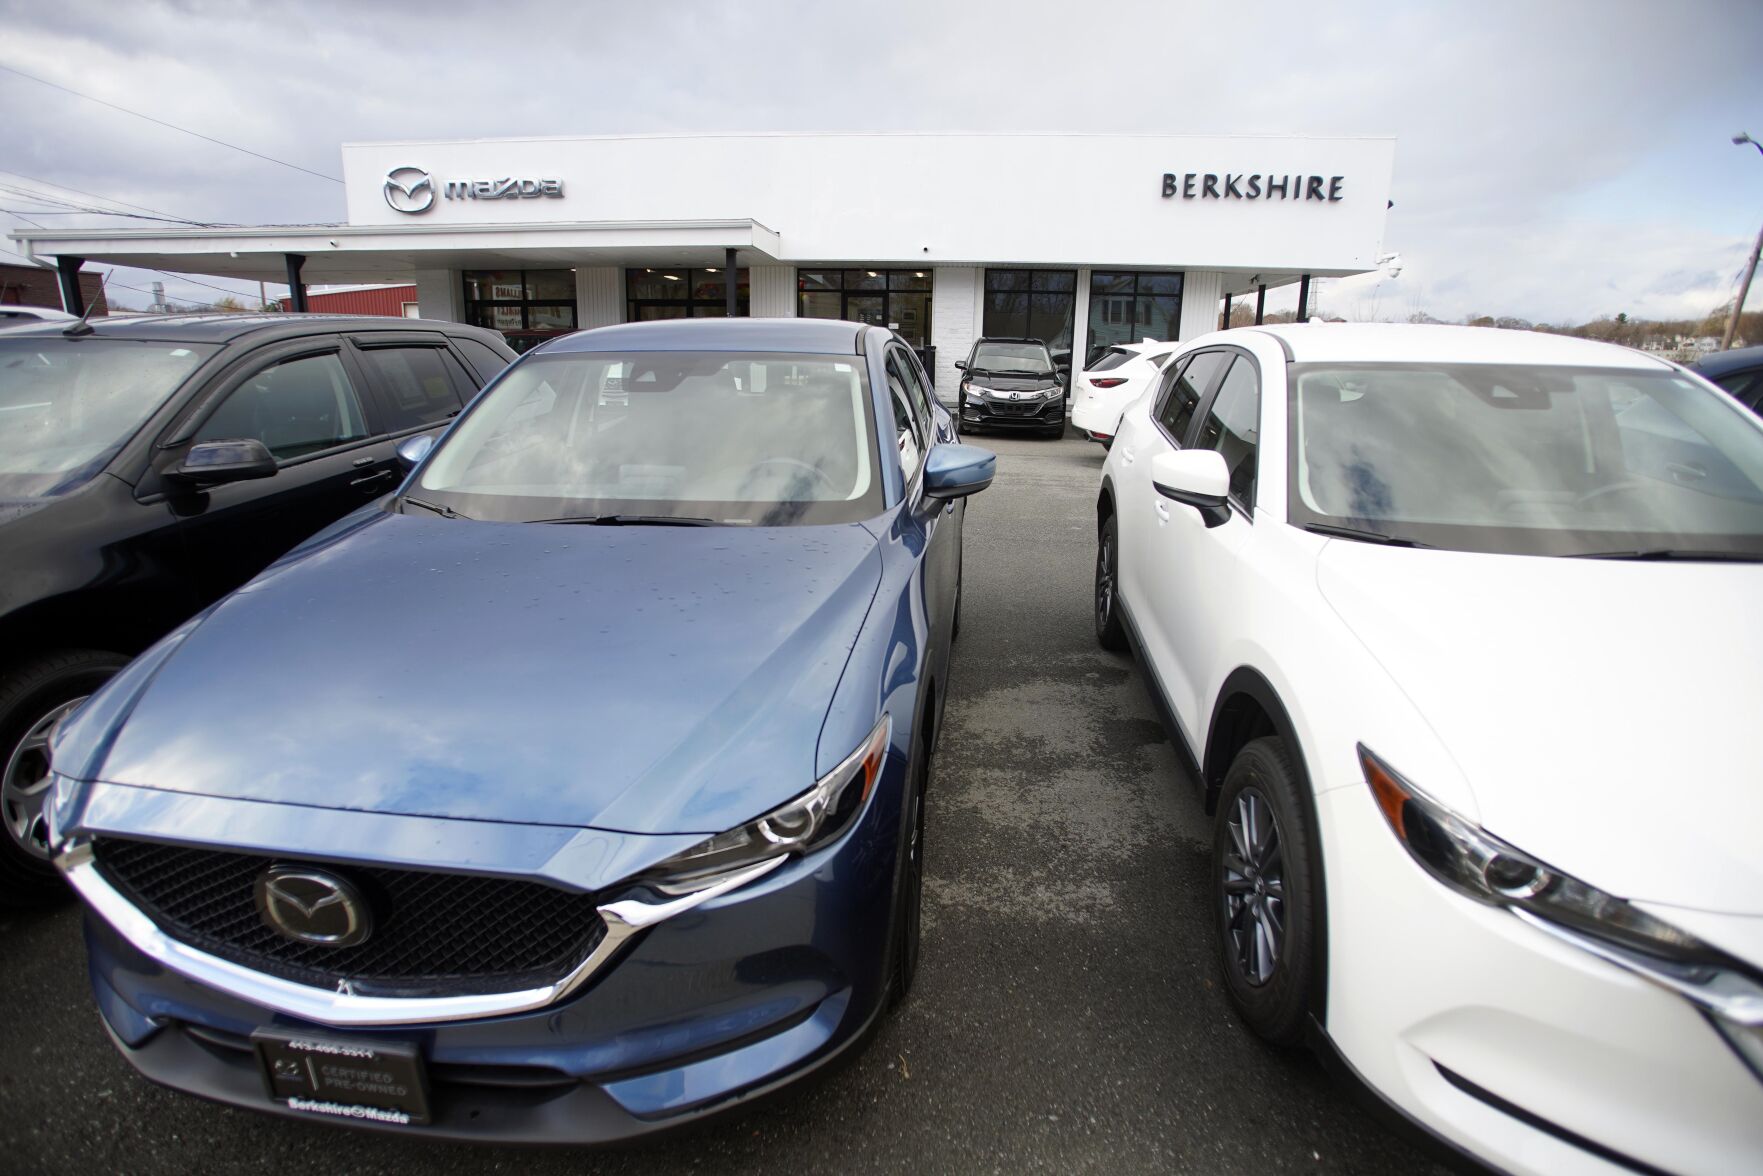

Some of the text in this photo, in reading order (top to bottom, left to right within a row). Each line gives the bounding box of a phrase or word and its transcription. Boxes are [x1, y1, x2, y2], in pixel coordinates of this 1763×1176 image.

[1161, 172, 1345, 201] BERKSHIRE
[321, 1065, 392, 1084] CERTIFIED
[325, 1077, 407, 1097] PRE-OWNED
[288, 1096, 409, 1124] Berkshire Mazda
